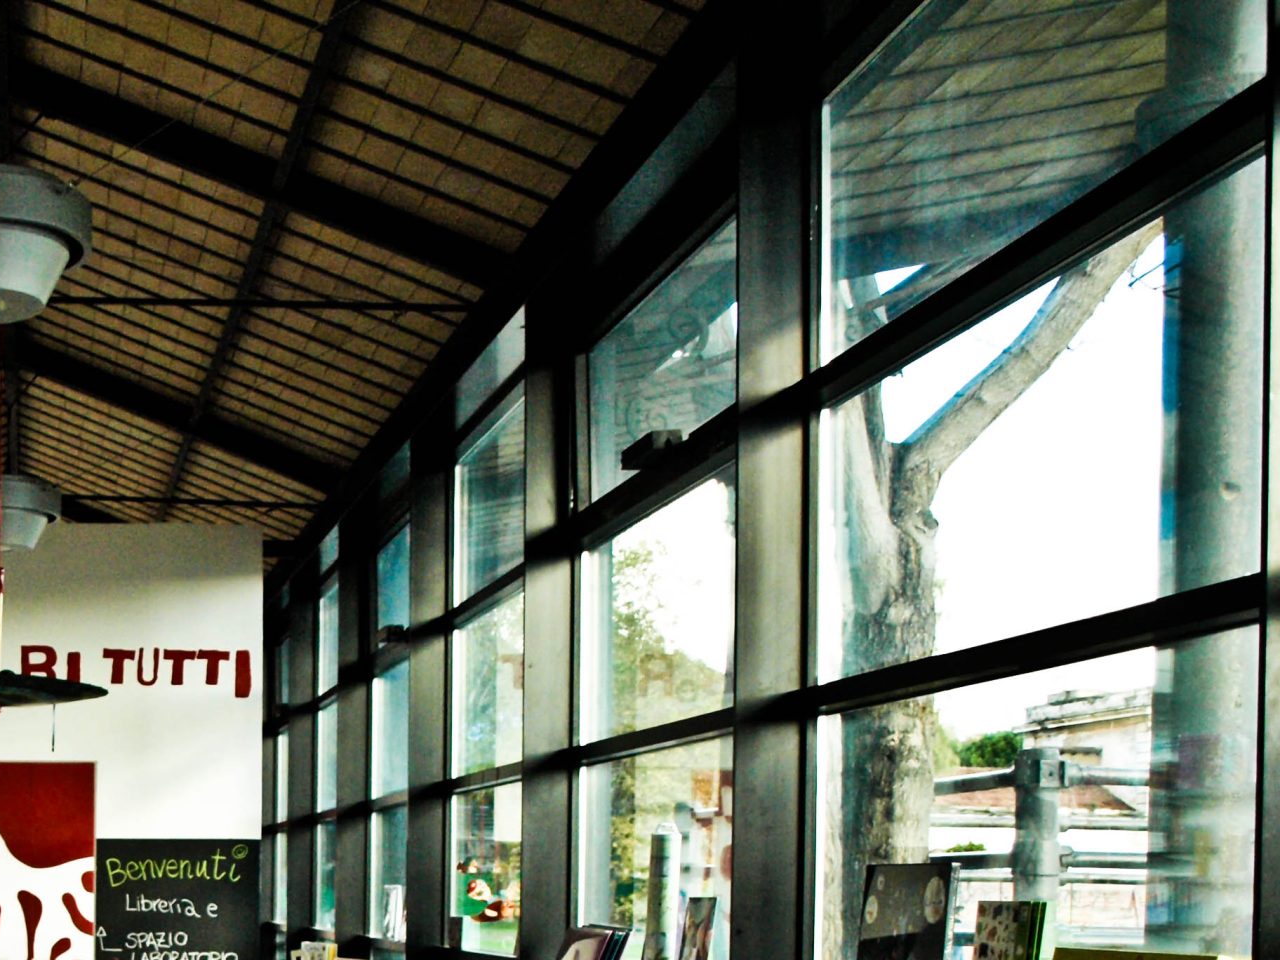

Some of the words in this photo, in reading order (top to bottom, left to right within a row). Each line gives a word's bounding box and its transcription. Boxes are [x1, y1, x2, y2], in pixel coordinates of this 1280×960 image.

[103, 647, 252, 698] TUTTI
[106, 844, 249, 887] Benvenuti
[126, 893, 201, 918] Libreria
[206, 902, 218, 917] e
[125, 931, 189, 951] SPAZIO
